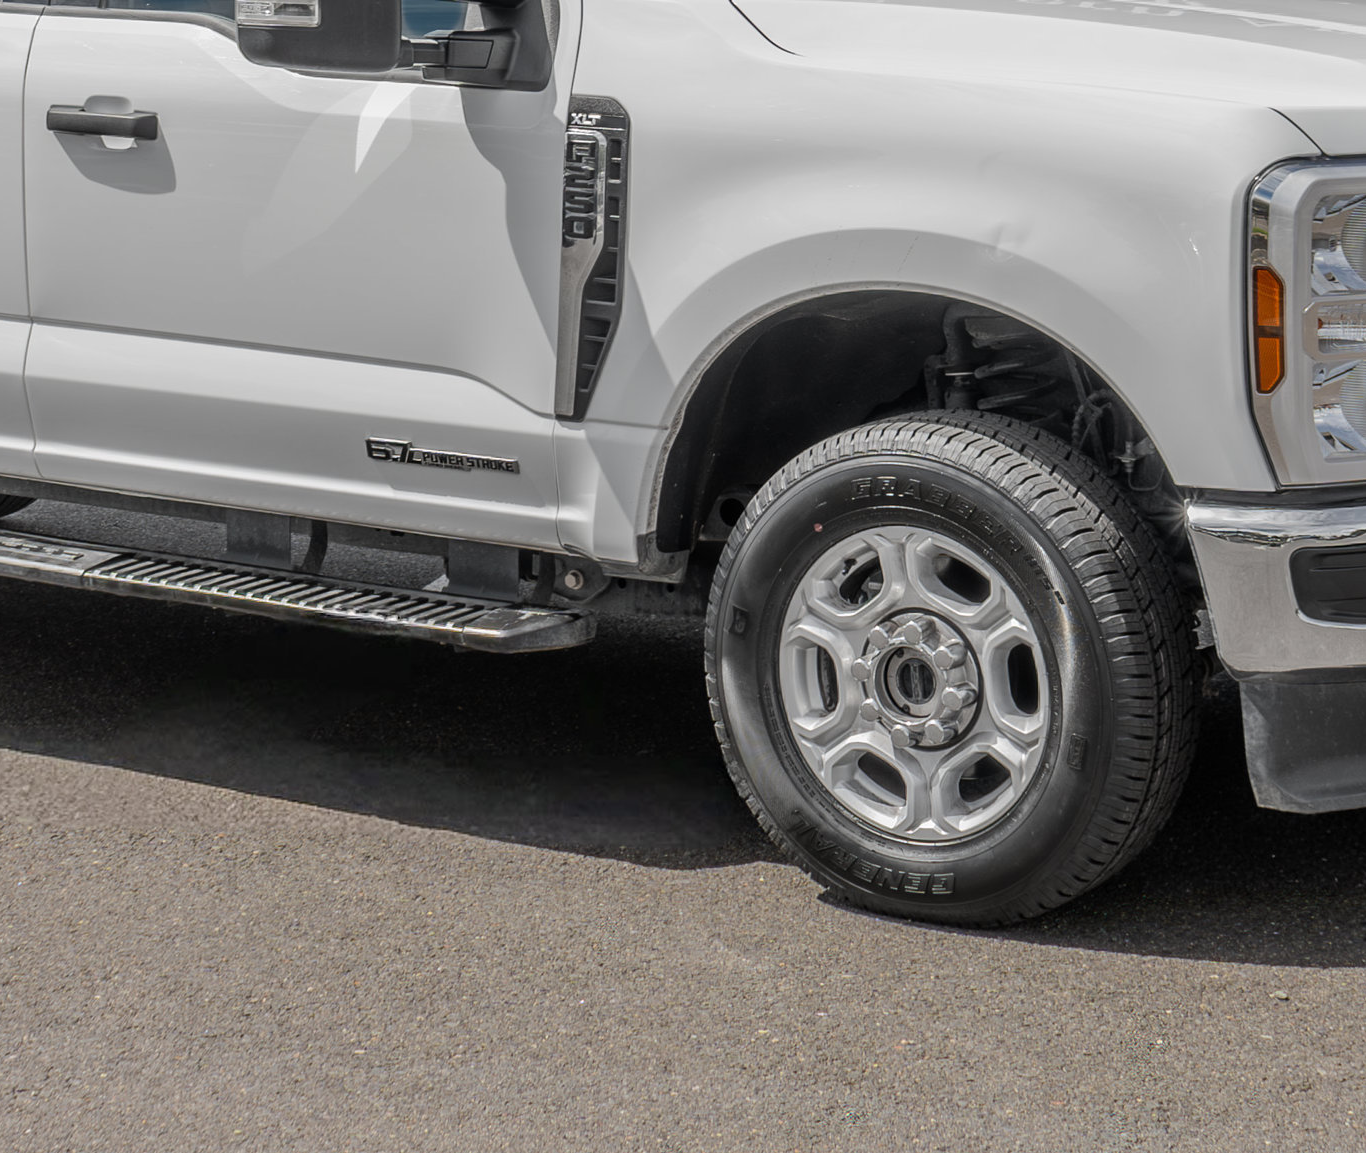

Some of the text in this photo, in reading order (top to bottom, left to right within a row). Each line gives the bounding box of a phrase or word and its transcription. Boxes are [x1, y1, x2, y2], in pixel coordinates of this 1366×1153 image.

[570, 113, 601, 126] XLT
[365, 436, 422, 465] 6.7L
[422, 451, 464, 466] POWER
[468, 456, 515, 472] STROKE
[850, 475, 1022, 555] GRABBER
[787, 809, 955, 895] GENERAL
